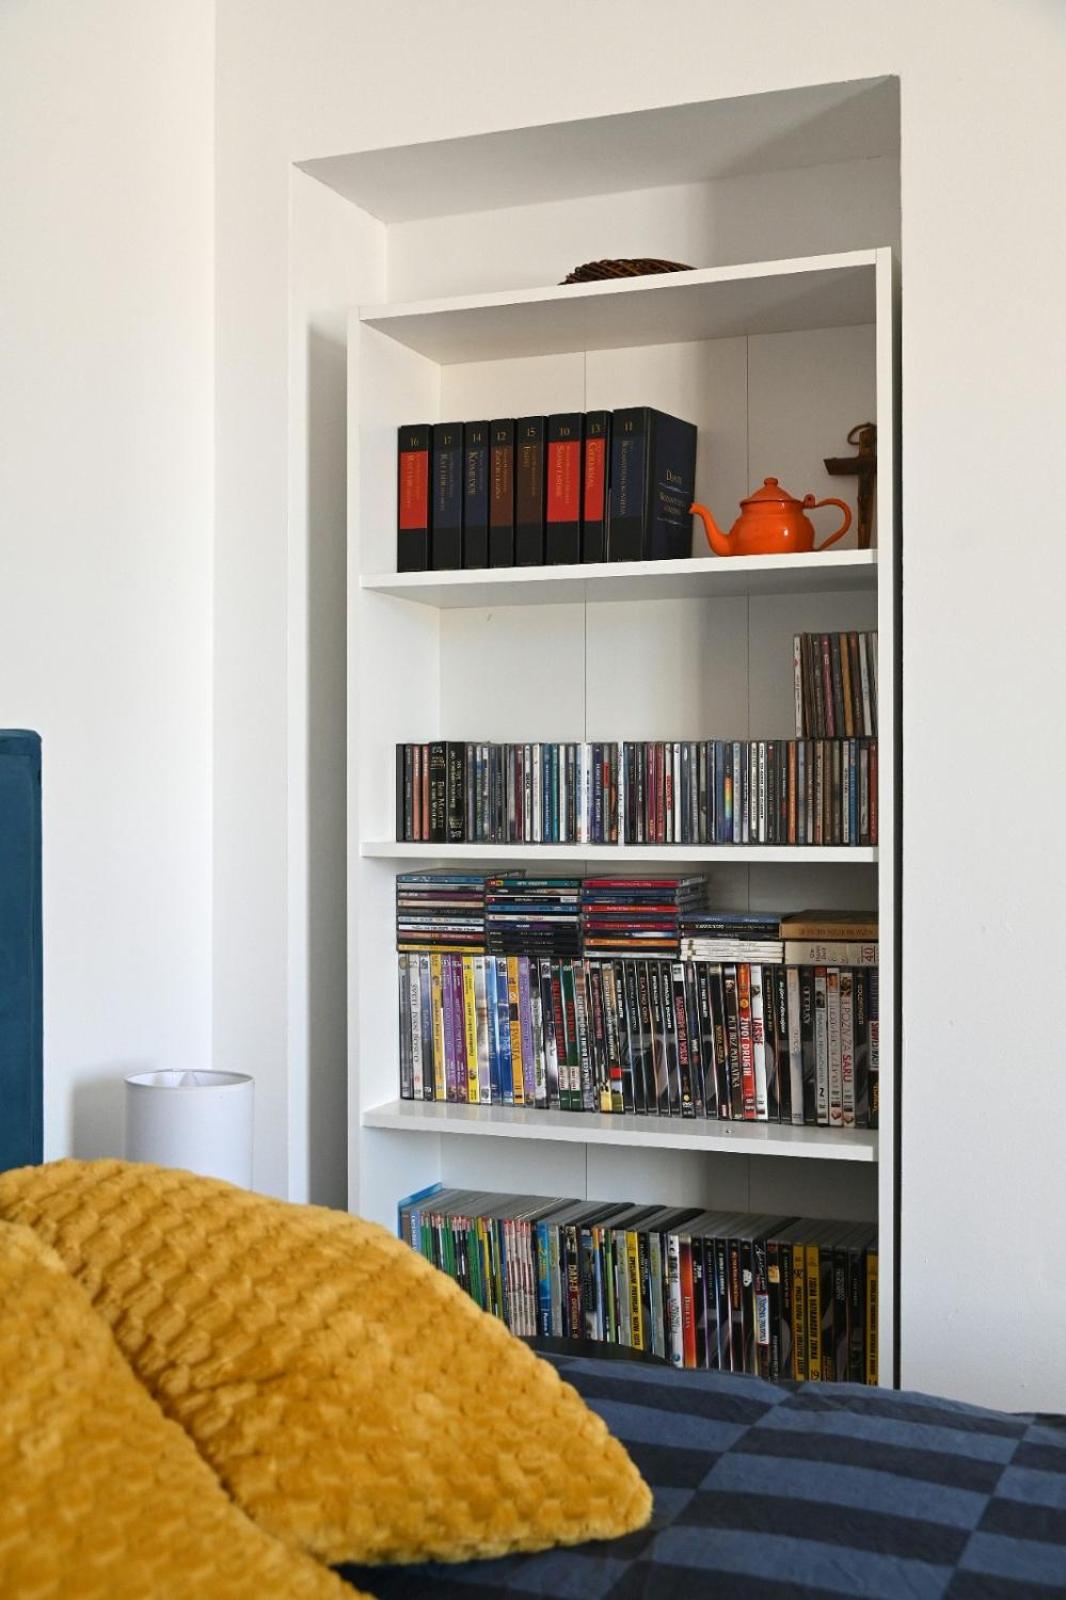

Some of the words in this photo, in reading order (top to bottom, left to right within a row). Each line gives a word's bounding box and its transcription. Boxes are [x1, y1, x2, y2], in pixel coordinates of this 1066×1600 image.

[740, 1016, 750, 1042] ŽIVOT
[741, 1044, 752, 1076] DRUGIH
[842, 1054, 852, 1084] SARU
